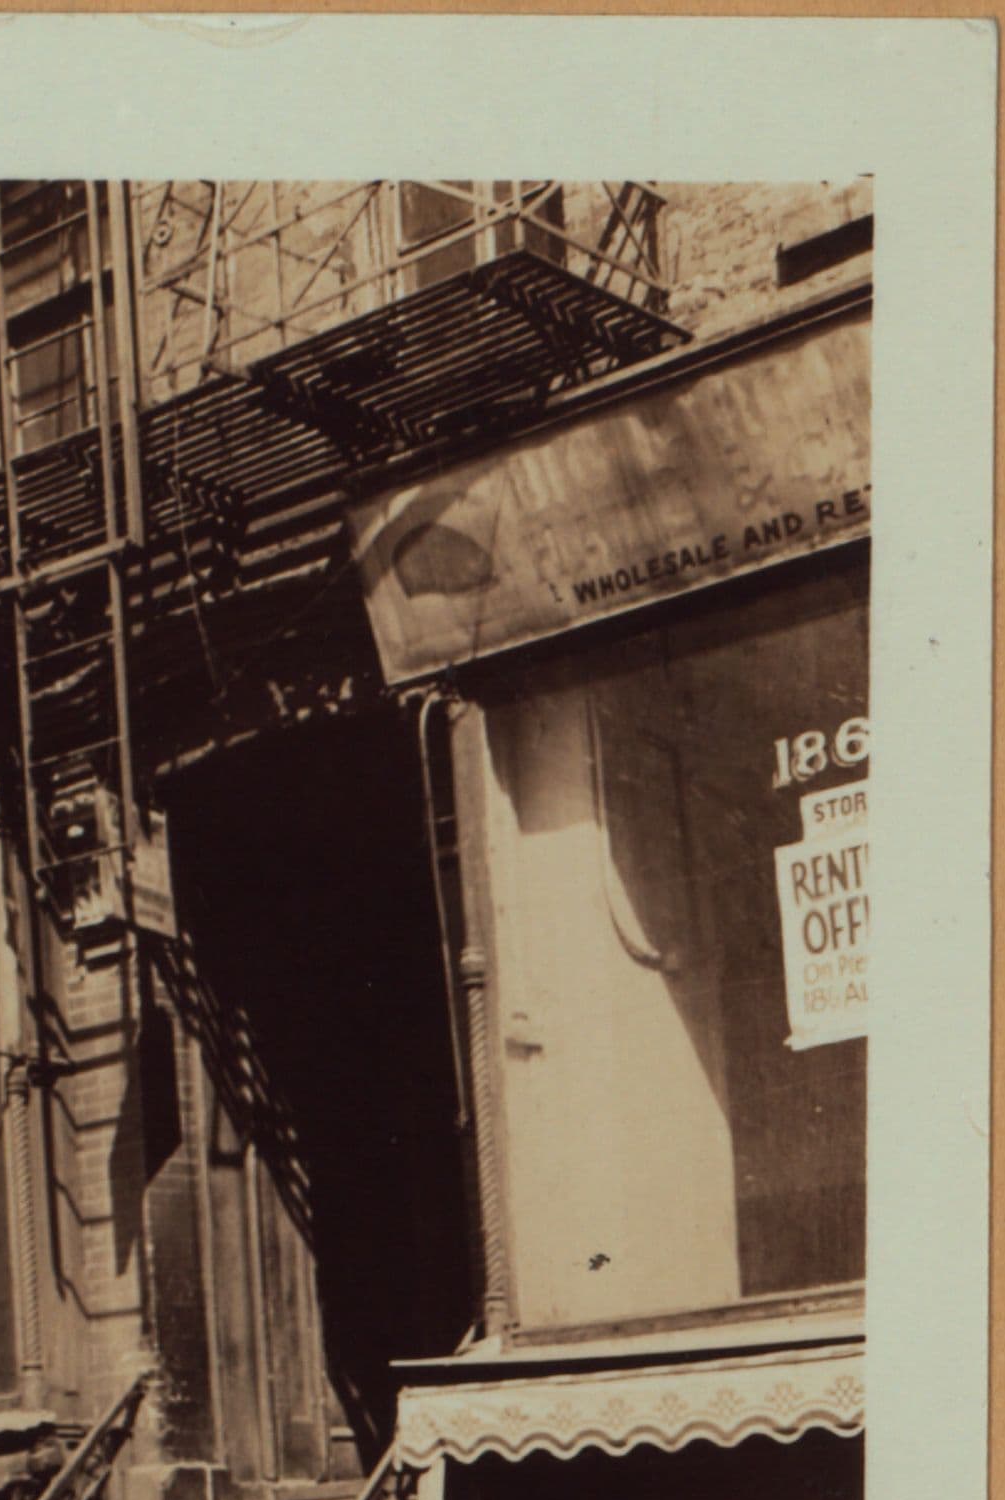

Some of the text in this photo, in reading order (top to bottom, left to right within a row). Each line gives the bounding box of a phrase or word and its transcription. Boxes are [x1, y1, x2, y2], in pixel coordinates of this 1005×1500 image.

[573, 533, 730, 604] WHOLESALE
[743, 512, 803, 548] AND
[773, 717, 869, 788] 186
